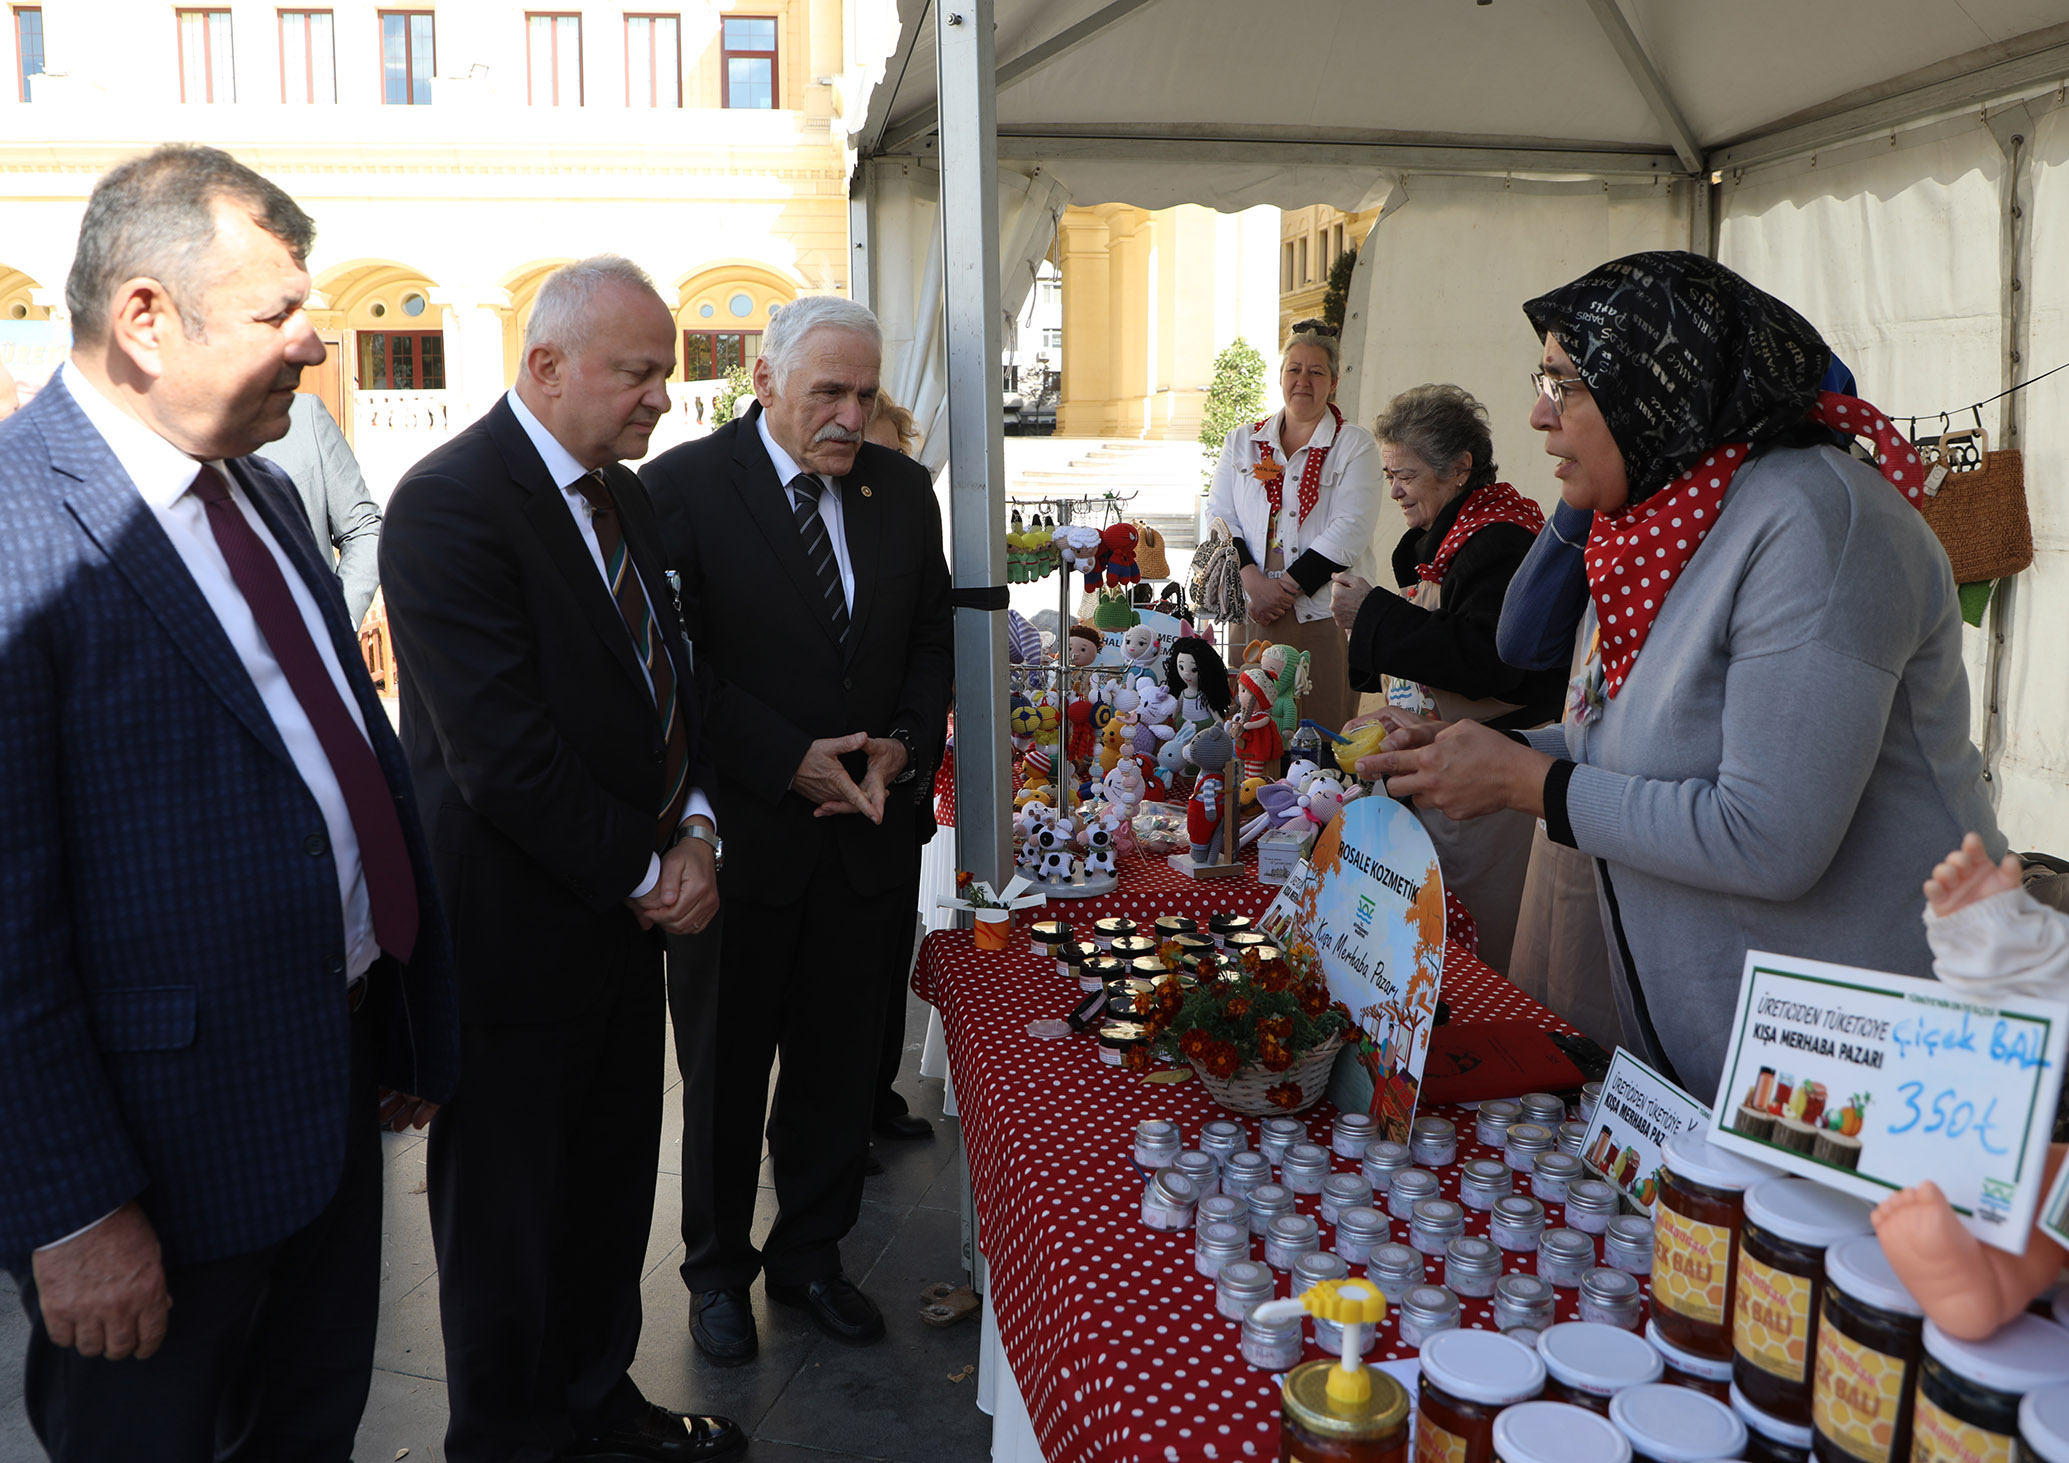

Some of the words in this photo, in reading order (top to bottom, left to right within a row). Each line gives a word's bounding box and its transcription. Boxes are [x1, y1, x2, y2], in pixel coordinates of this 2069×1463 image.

[1576, 311, 1605, 326] PARIS
[1633, 313, 1660, 341] PARIS
[1692, 312, 1719, 344] PARIS
[1640, 351, 1676, 393] PARIS
[1785, 341, 1806, 384] PARIS
[1337, 840, 1371, 874] ROSALE
[1369, 860, 1421, 904] KOZMETİK
[1314, 917, 1333, 950] Kışa
[1331, 932, 1369, 979] Merhaba
[1369, 960, 1399, 1000] Pazarı
[1757, 991, 1822, 1026] ÜRETİCİDEN
[1823, 1006, 1890, 1041] TÜKETİCİYE
[1753, 1022, 1777, 1046] KIŞA
[1779, 1029, 1835, 1058] MERHABA
[1838, 1042, 1884, 1069] PAZARI
[1604, 1092, 1620, 1114] KIŞA
[1618, 1103, 1650, 1140] MERHABA
[1649, 1127, 1668, 1148] PAZ
[1611, 1071, 1647, 1111] ÜRETİCİDEN
[1645, 1098, 1682, 1135] TÜKETİCİYE
[1672, 1251, 1713, 1283] BALI
[1752, 1300, 1793, 1337] BALI
[1835, 1376, 1881, 1420] BALI
